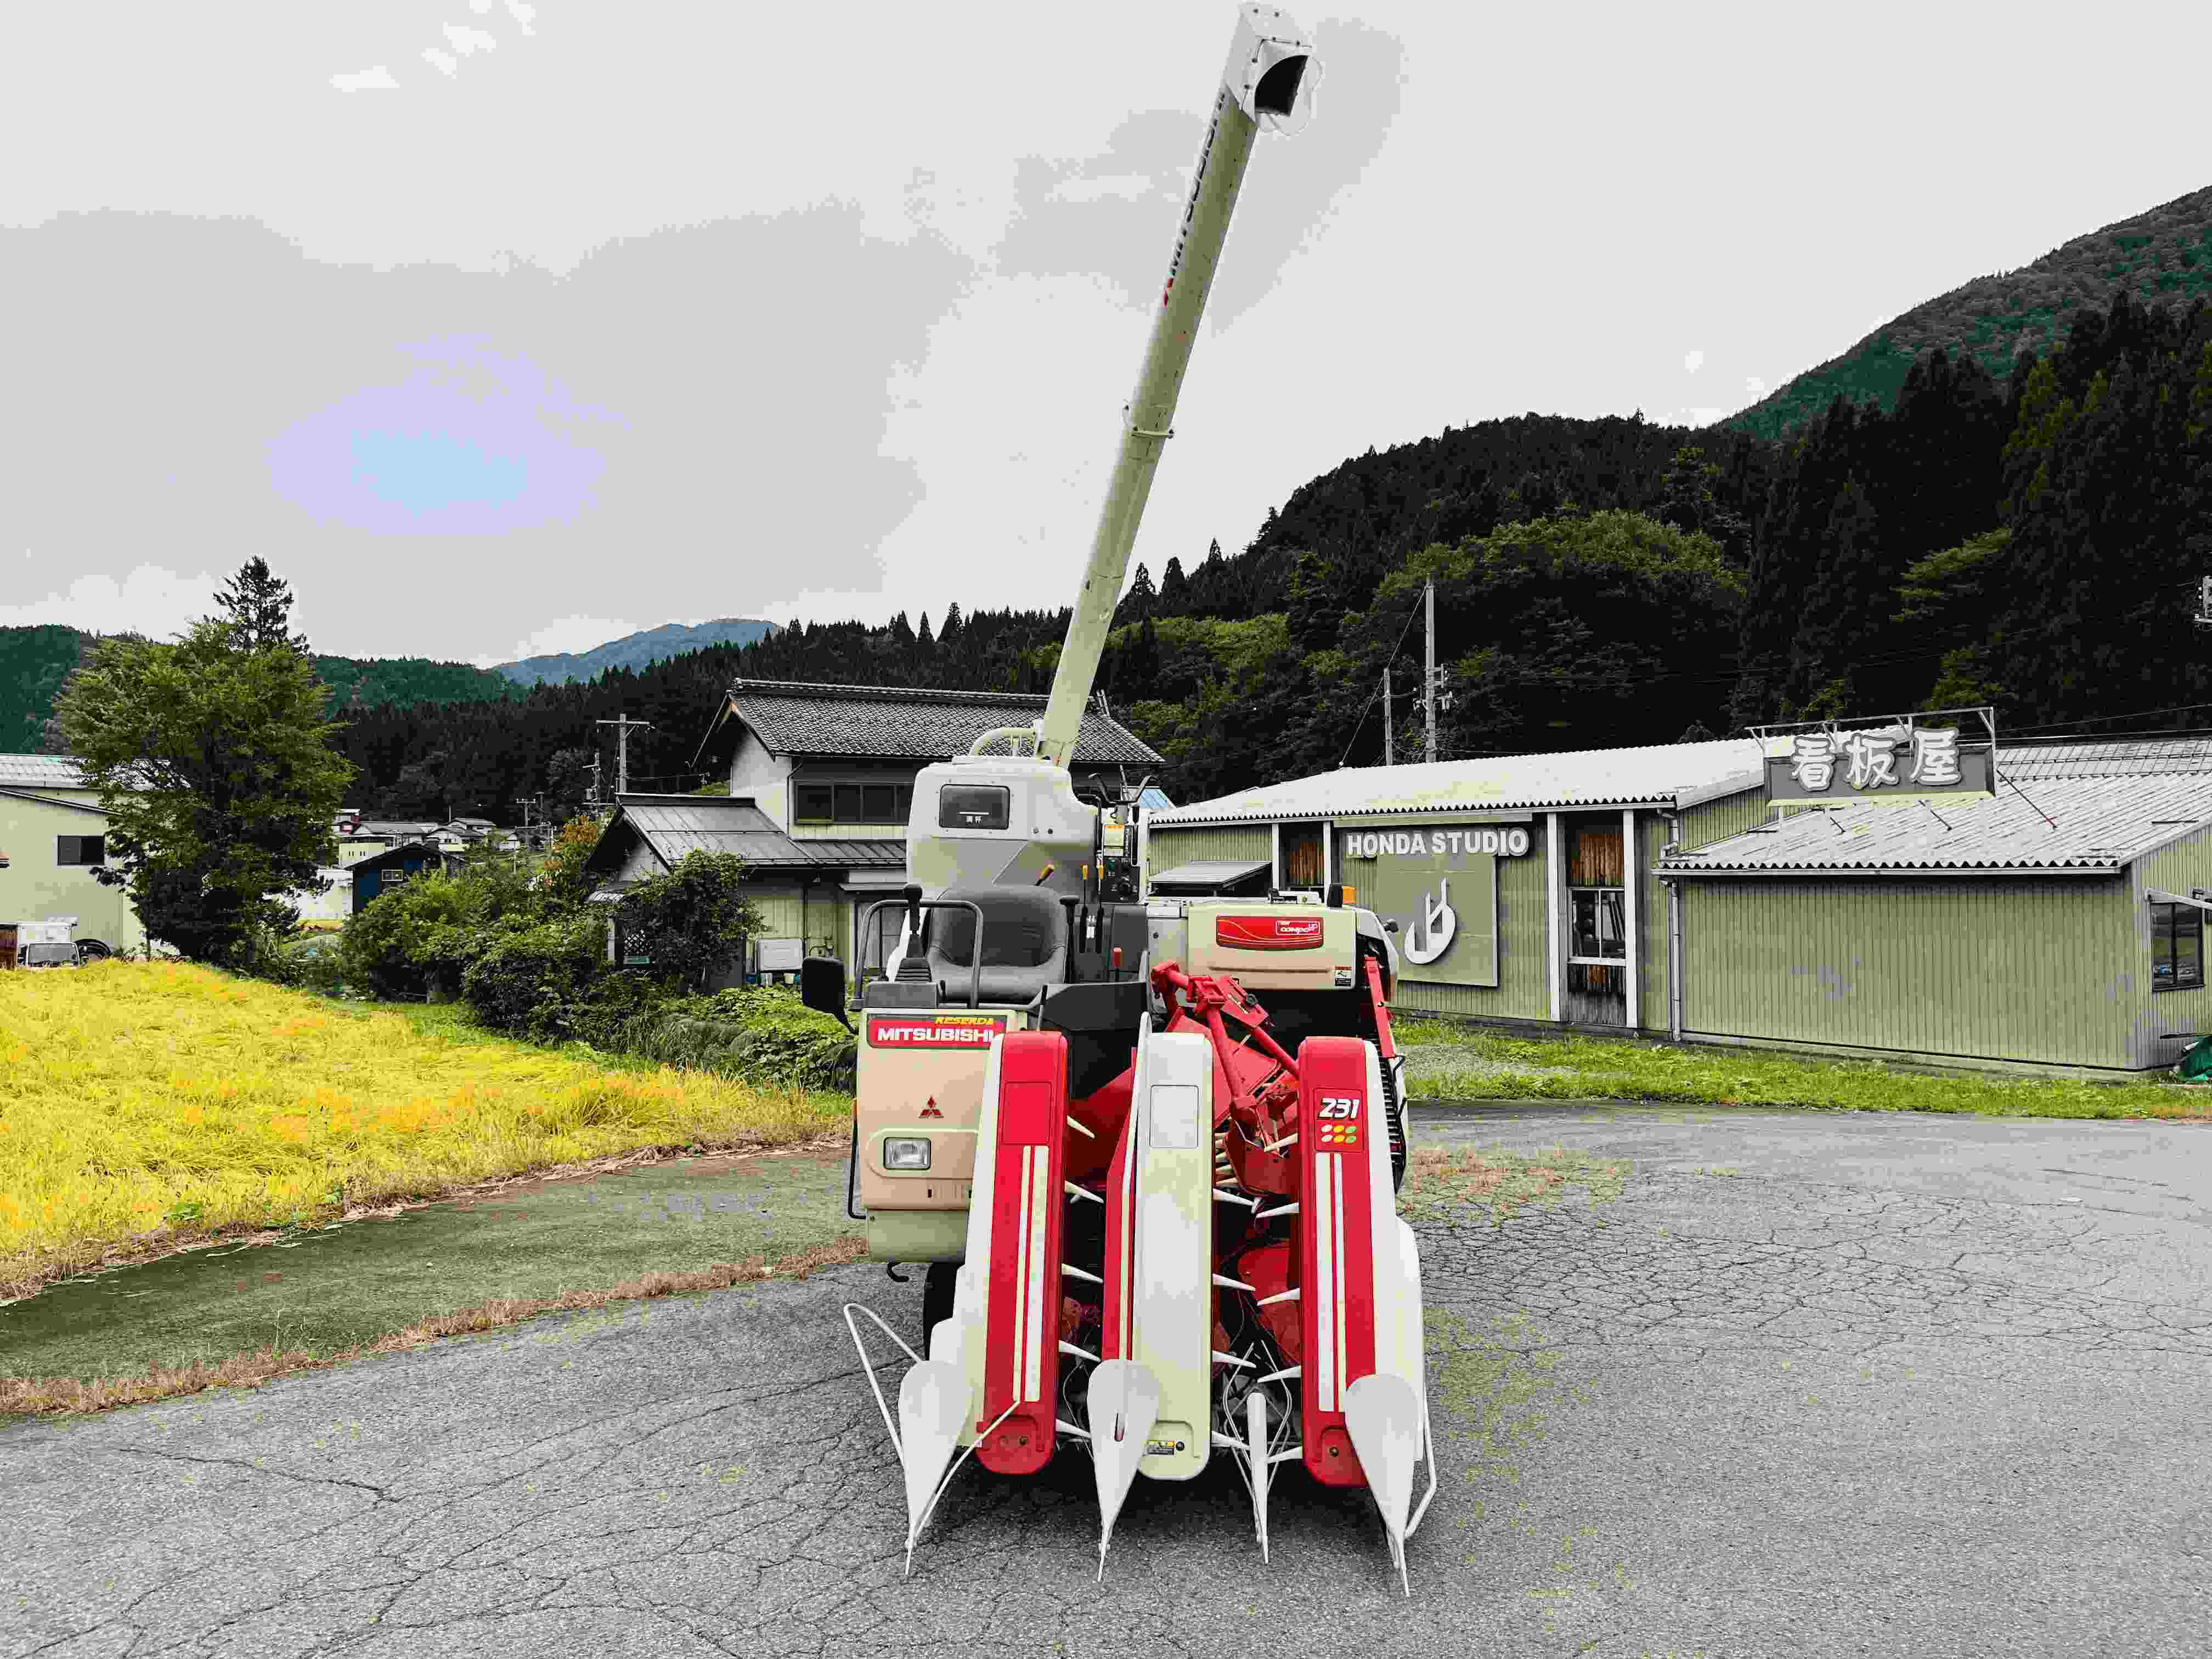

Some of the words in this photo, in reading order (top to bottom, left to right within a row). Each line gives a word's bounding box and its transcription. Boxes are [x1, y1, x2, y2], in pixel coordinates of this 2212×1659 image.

[1791, 728, 1961, 791] 看板屋
[1346, 833, 1426, 857] HONDA
[1432, 828, 1529, 856] STUDIO
[877, 1028, 994, 1042] MITSUBISHI
[1318, 1097, 1360, 1119] 231
